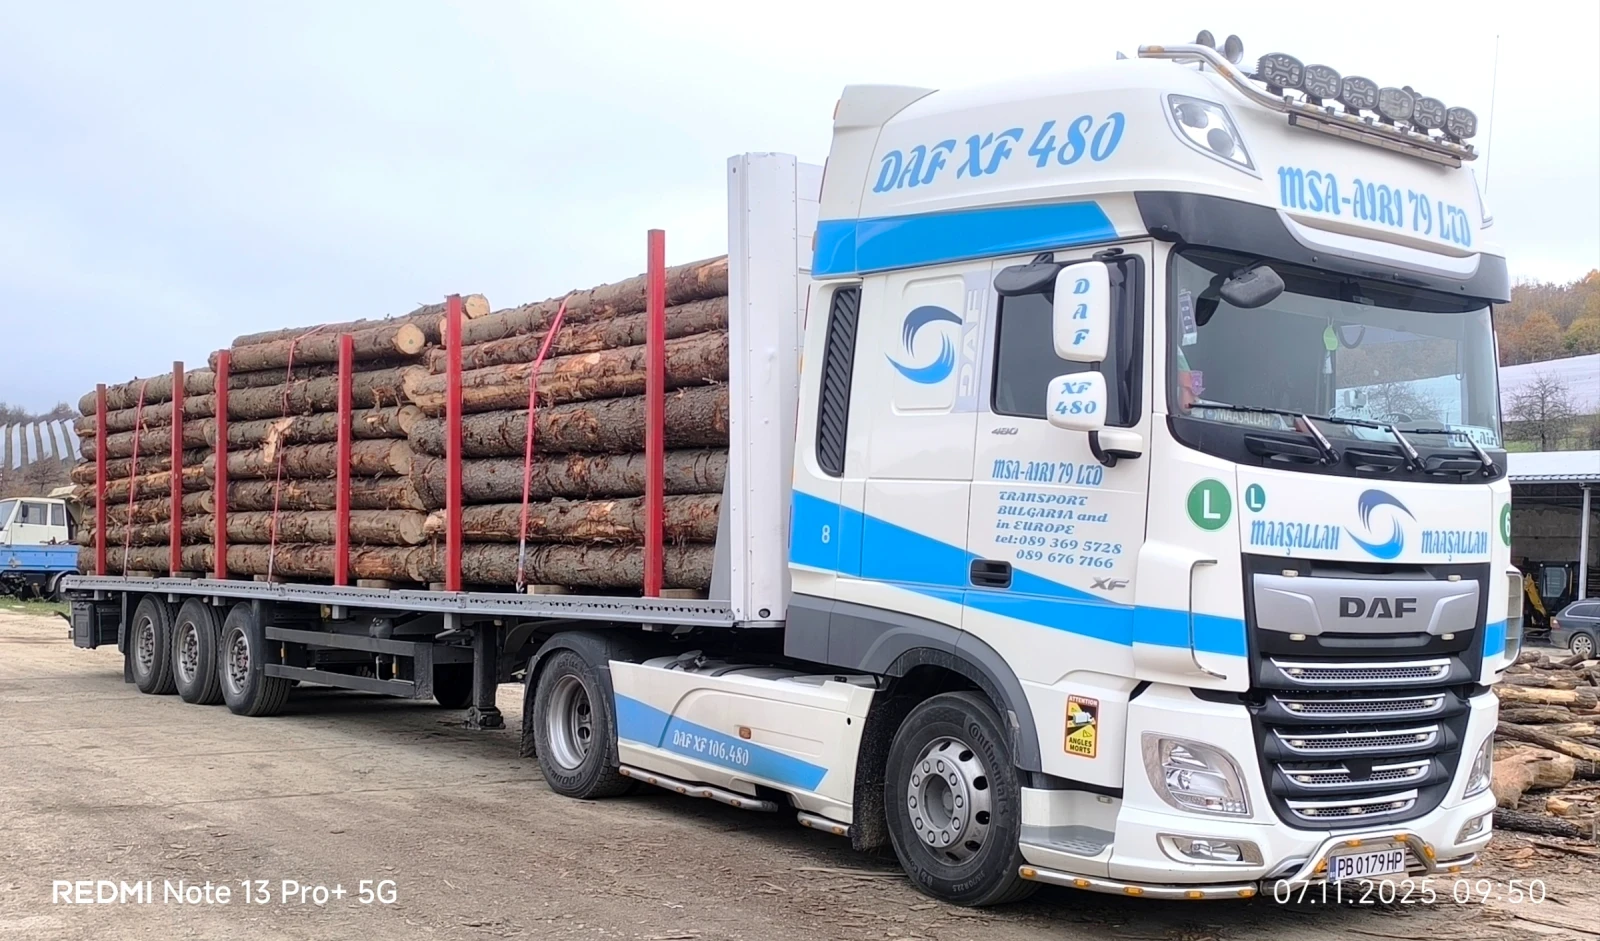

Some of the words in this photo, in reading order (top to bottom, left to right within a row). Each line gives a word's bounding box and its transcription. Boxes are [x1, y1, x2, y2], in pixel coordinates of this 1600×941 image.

[872, 139, 957, 193] DAF
[956, 127, 1024, 180] XF
[1028, 112, 1125, 168] 480
[1408, 189, 1433, 235] 79
[1438, 201, 1472, 247] LTD
[1061, 381, 1092, 395] XF
[1055, 400, 1097, 415] 480
[991, 427, 1019, 436] 480
[1058, 462, 1073, 484] 79
[1076, 464, 1103, 486] LTD
[998, 491, 1088, 506] TRANSPORT
[1203, 489, 1221, 520] L
[1249, 487, 1262, 509] L
[997, 505, 1074, 520] BULGARIA
[1077, 513, 1108, 523] and
[821, 524, 831, 544] 8
[996, 519, 1009, 530] in
[1013, 521, 1075, 535] EUROPE
[1049, 538, 1079, 550] 369
[1082, 540, 1122, 555] 5728
[1016, 549, 1043, 561] 089
[1047, 552, 1074, 565] 676
[1079, 555, 1114, 569] 7166
[1089, 576, 1130, 591] XF
[1339, 596, 1417, 619] DAF
[1069, 696, 1098, 706] ATTENTION
[673, 729, 693, 747] DAF
[693, 735, 708, 753] XF
[708, 739, 750, 767] 106.480
[1069, 737, 1092, 747] ANGLES
[1070, 744, 1091, 754] MORTS
[1338, 857, 1353, 878] PB
[1356, 854, 1386, 875] 0179
[1387, 851, 1403, 871] HP
